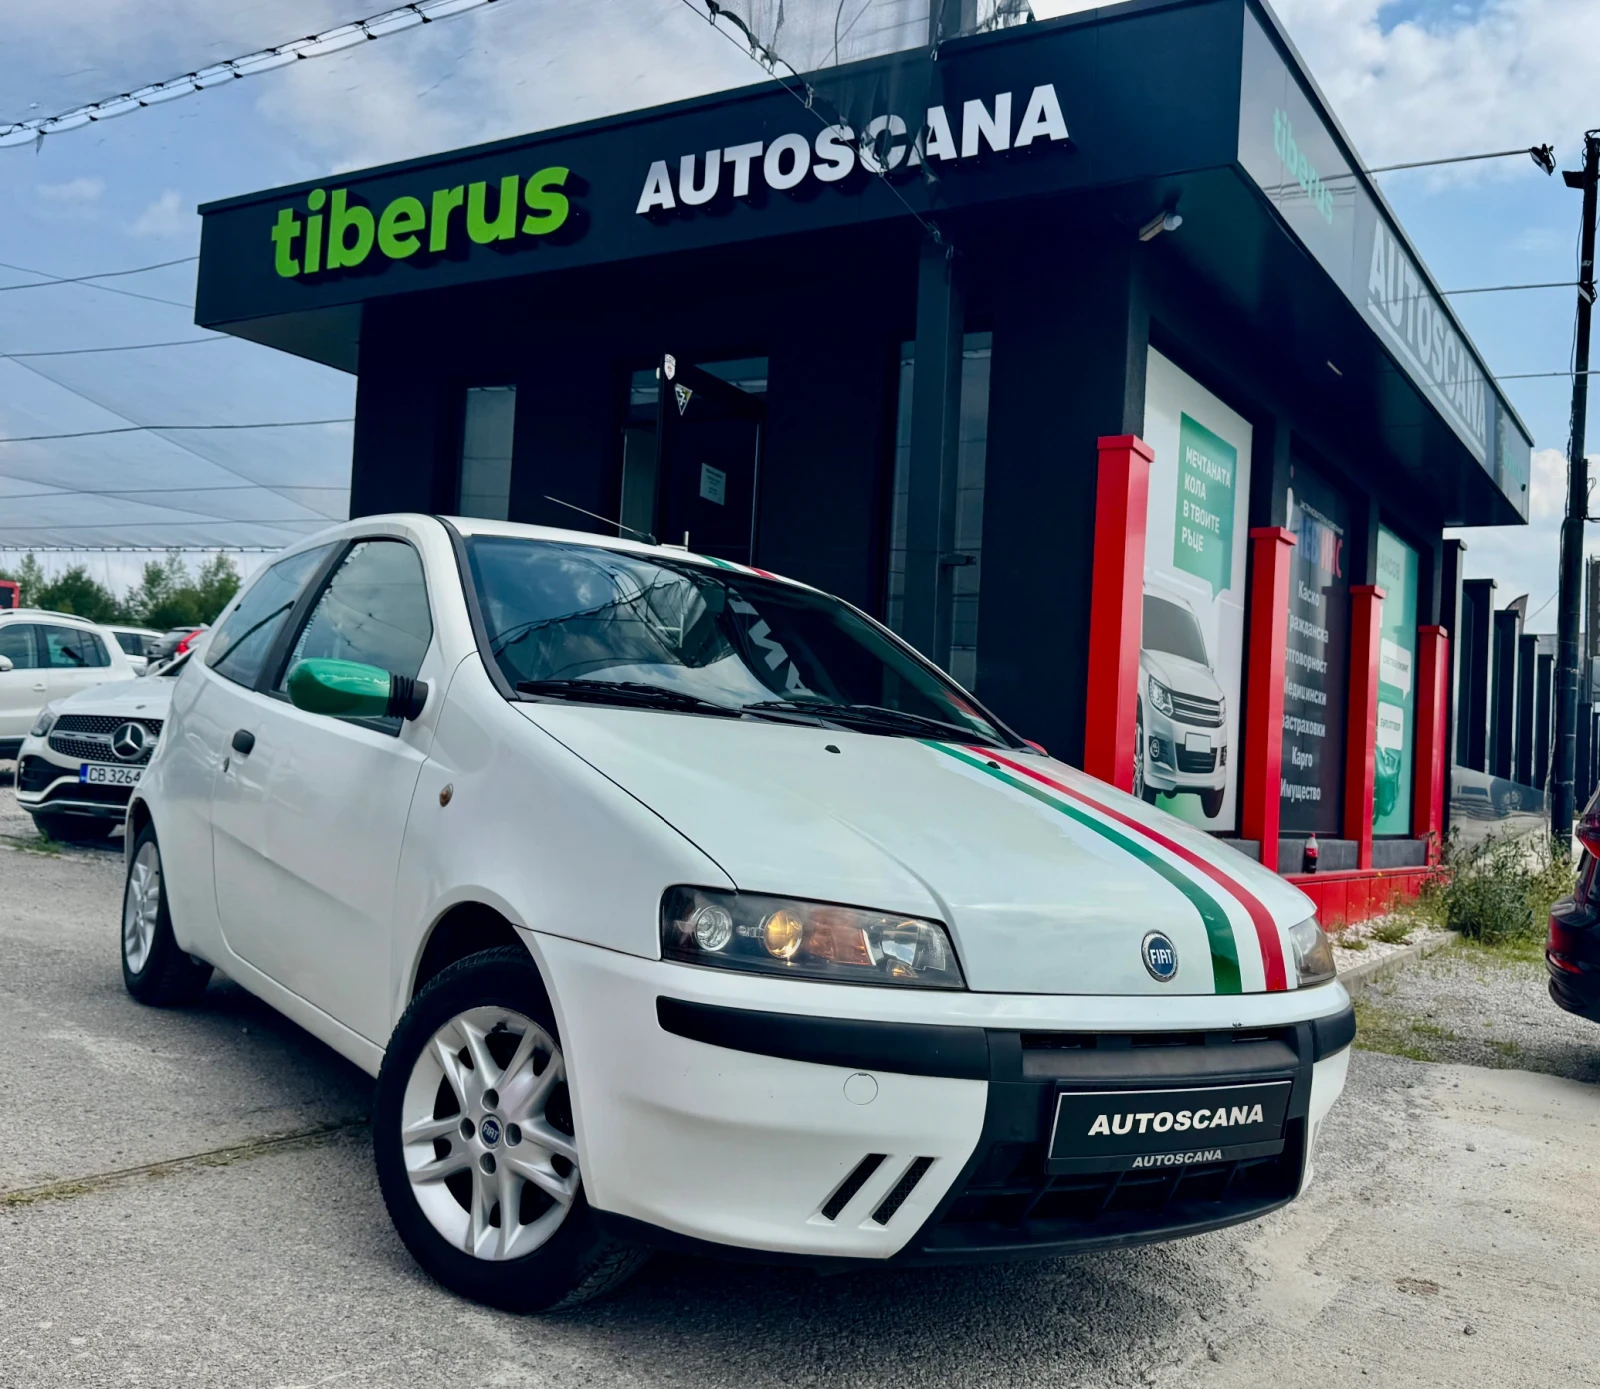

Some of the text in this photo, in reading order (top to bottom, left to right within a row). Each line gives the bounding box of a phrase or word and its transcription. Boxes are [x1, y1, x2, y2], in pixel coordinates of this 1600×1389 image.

[635, 83, 1069, 214] AUTOSCANA
[1273, 105, 1333, 224] tiberus
[271, 166, 570, 278] tiberus
[1368, 218, 1486, 447] AUTOSCANA
[1185, 446, 1231, 488] МЕЧТАНАТА
[1184, 472, 1206, 500] КОЛА
[1182, 499, 1220, 533] В ТВОИТЕ
[1181, 526, 1204, 552] РЪЦЕ
[1298, 579, 1320, 607] Каско
[1288, 608, 1329, 644] ражданска
[1291, 746, 1313, 770] Карго
[89, 767, 106, 782] CB
[1280, 778, 1321, 803] Имущество
[1150, 949, 1172, 964] FIAT
[483, 1123, 499, 1140] FIAT
[1088, 1104, 1264, 1136] AUTOSCANA
[1132, 1149, 1222, 1168] AUTOSCANA
